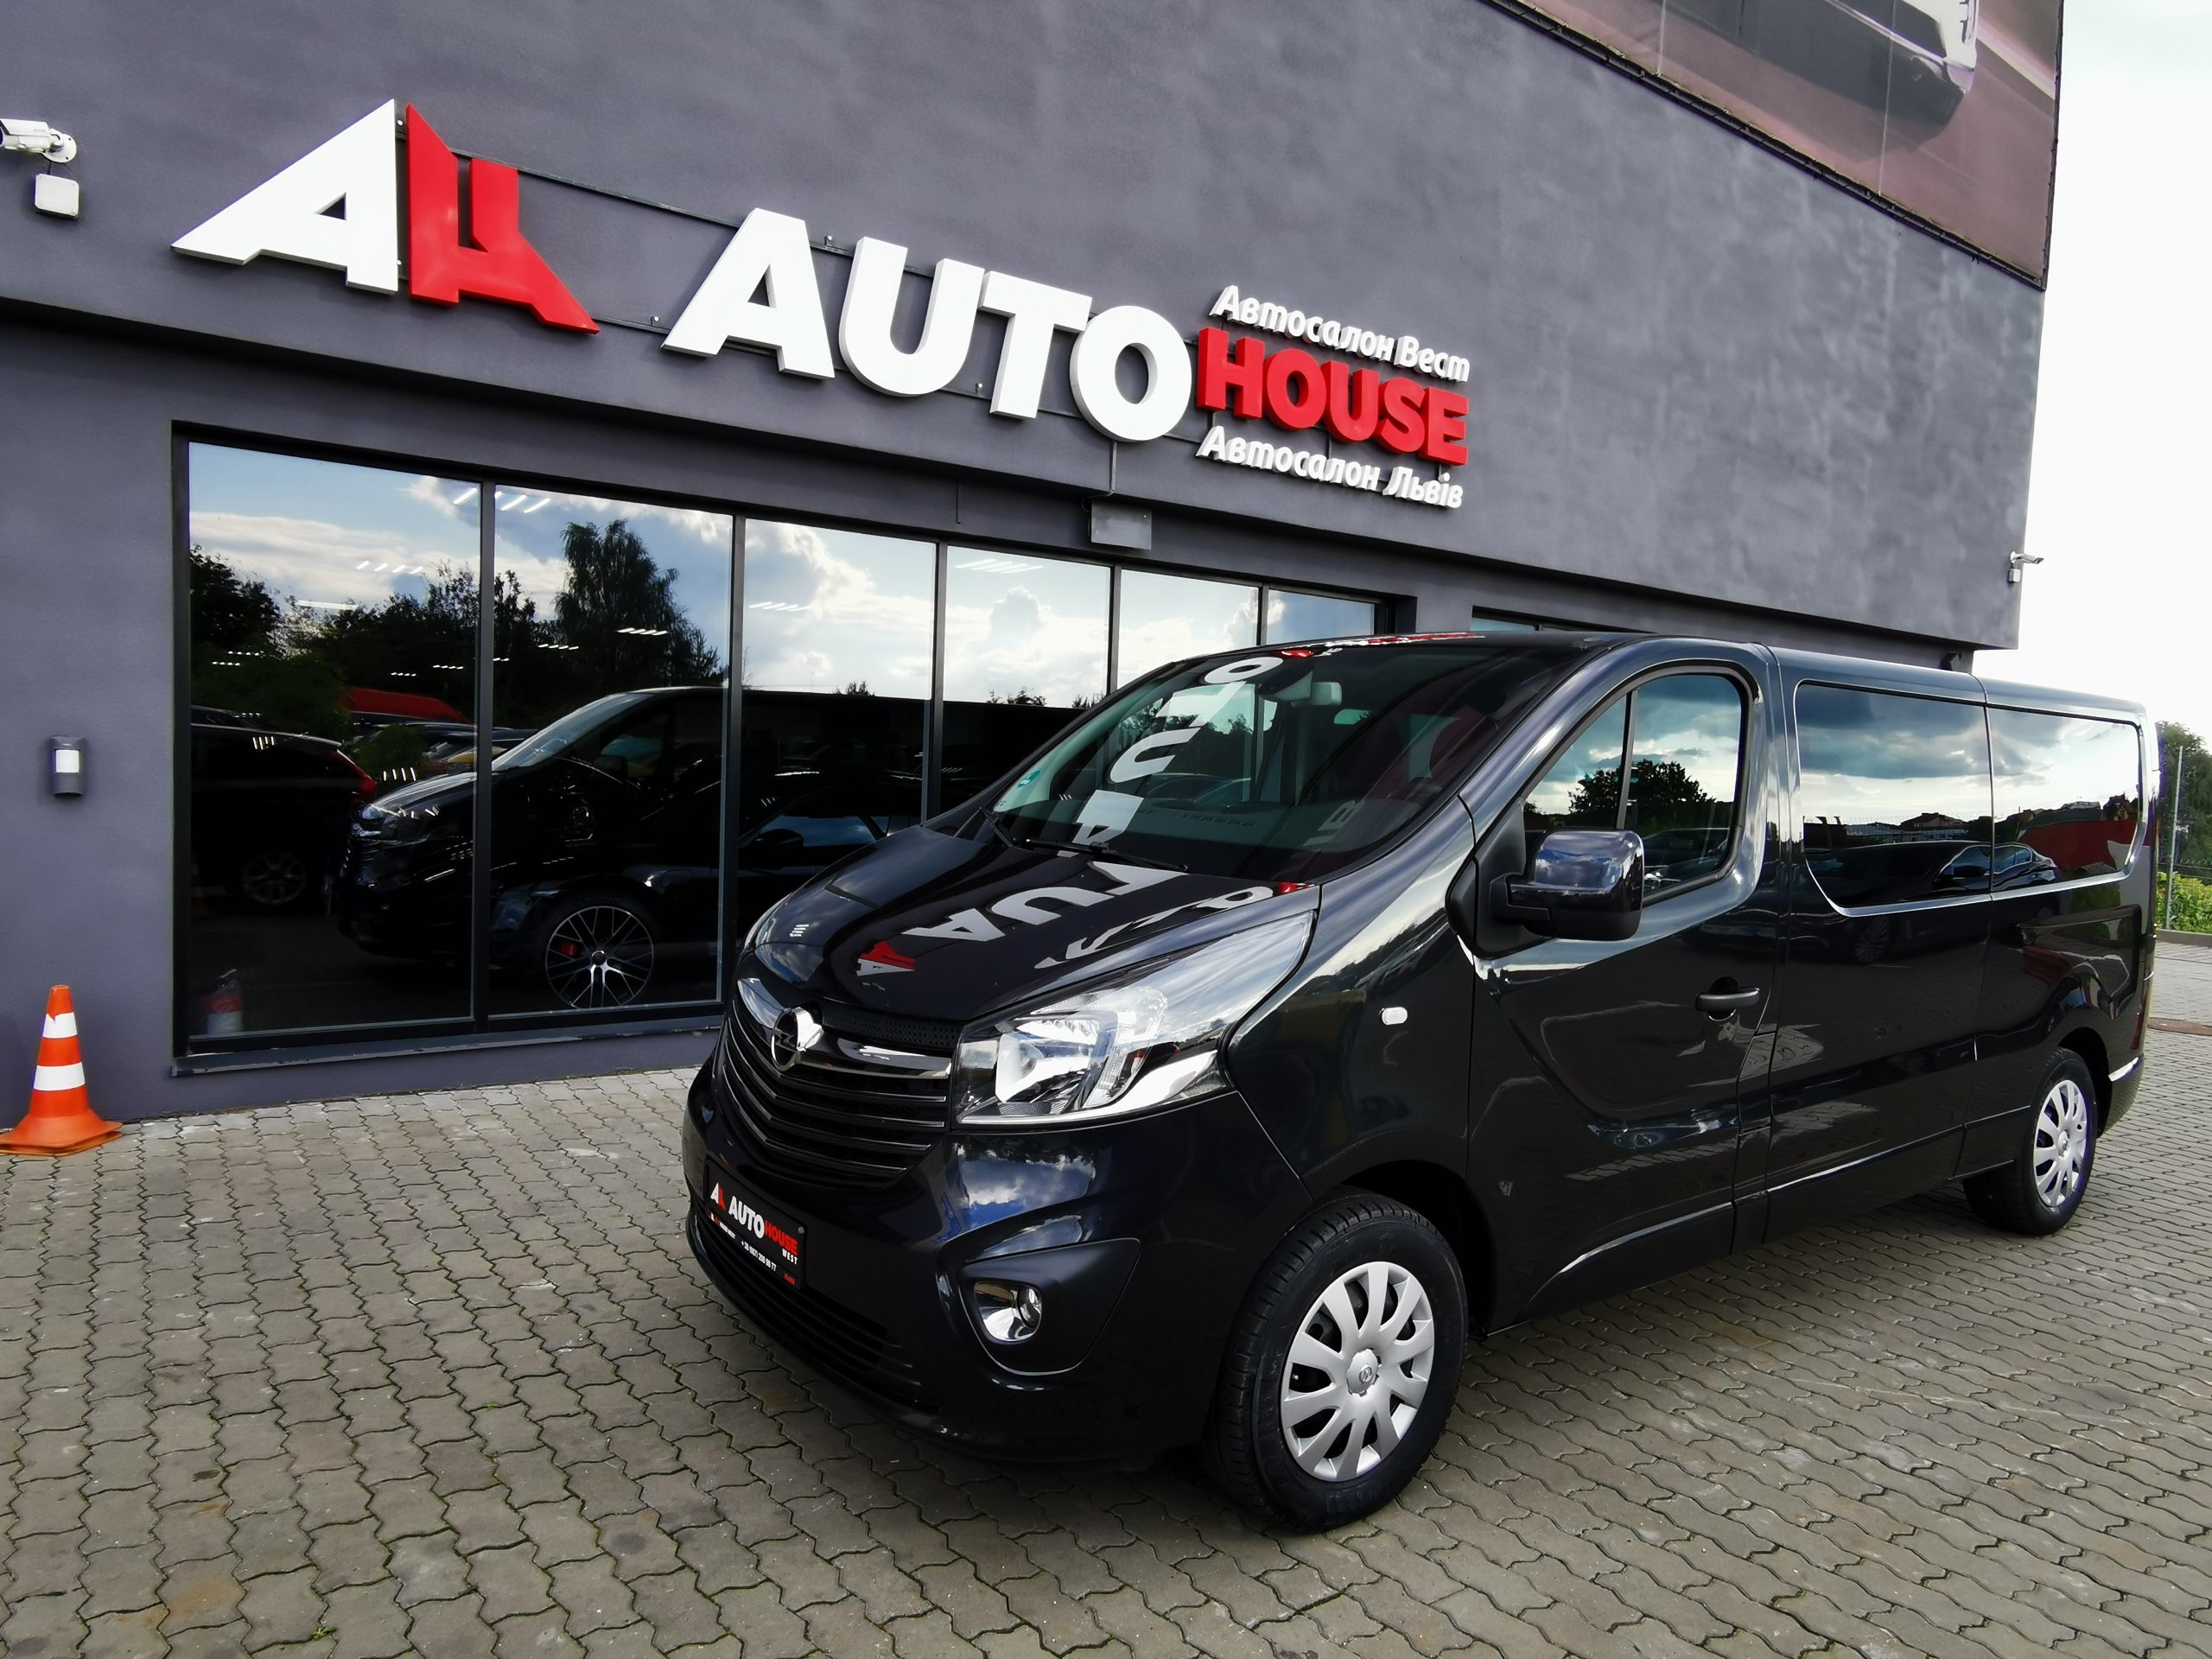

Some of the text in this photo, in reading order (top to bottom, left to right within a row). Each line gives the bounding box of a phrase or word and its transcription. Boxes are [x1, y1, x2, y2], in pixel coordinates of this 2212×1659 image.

[661, 207, 1469, 466] AUTO HOUSE
[1209, 285, 1471, 383] Автосалон Вест
[1195, 425, 1464, 510] Автосалон Львів
[728, 1196, 765, 1239] AUTO
[765, 1220, 798, 1255] HOUSE
[782, 1248, 798, 1265] WEST
